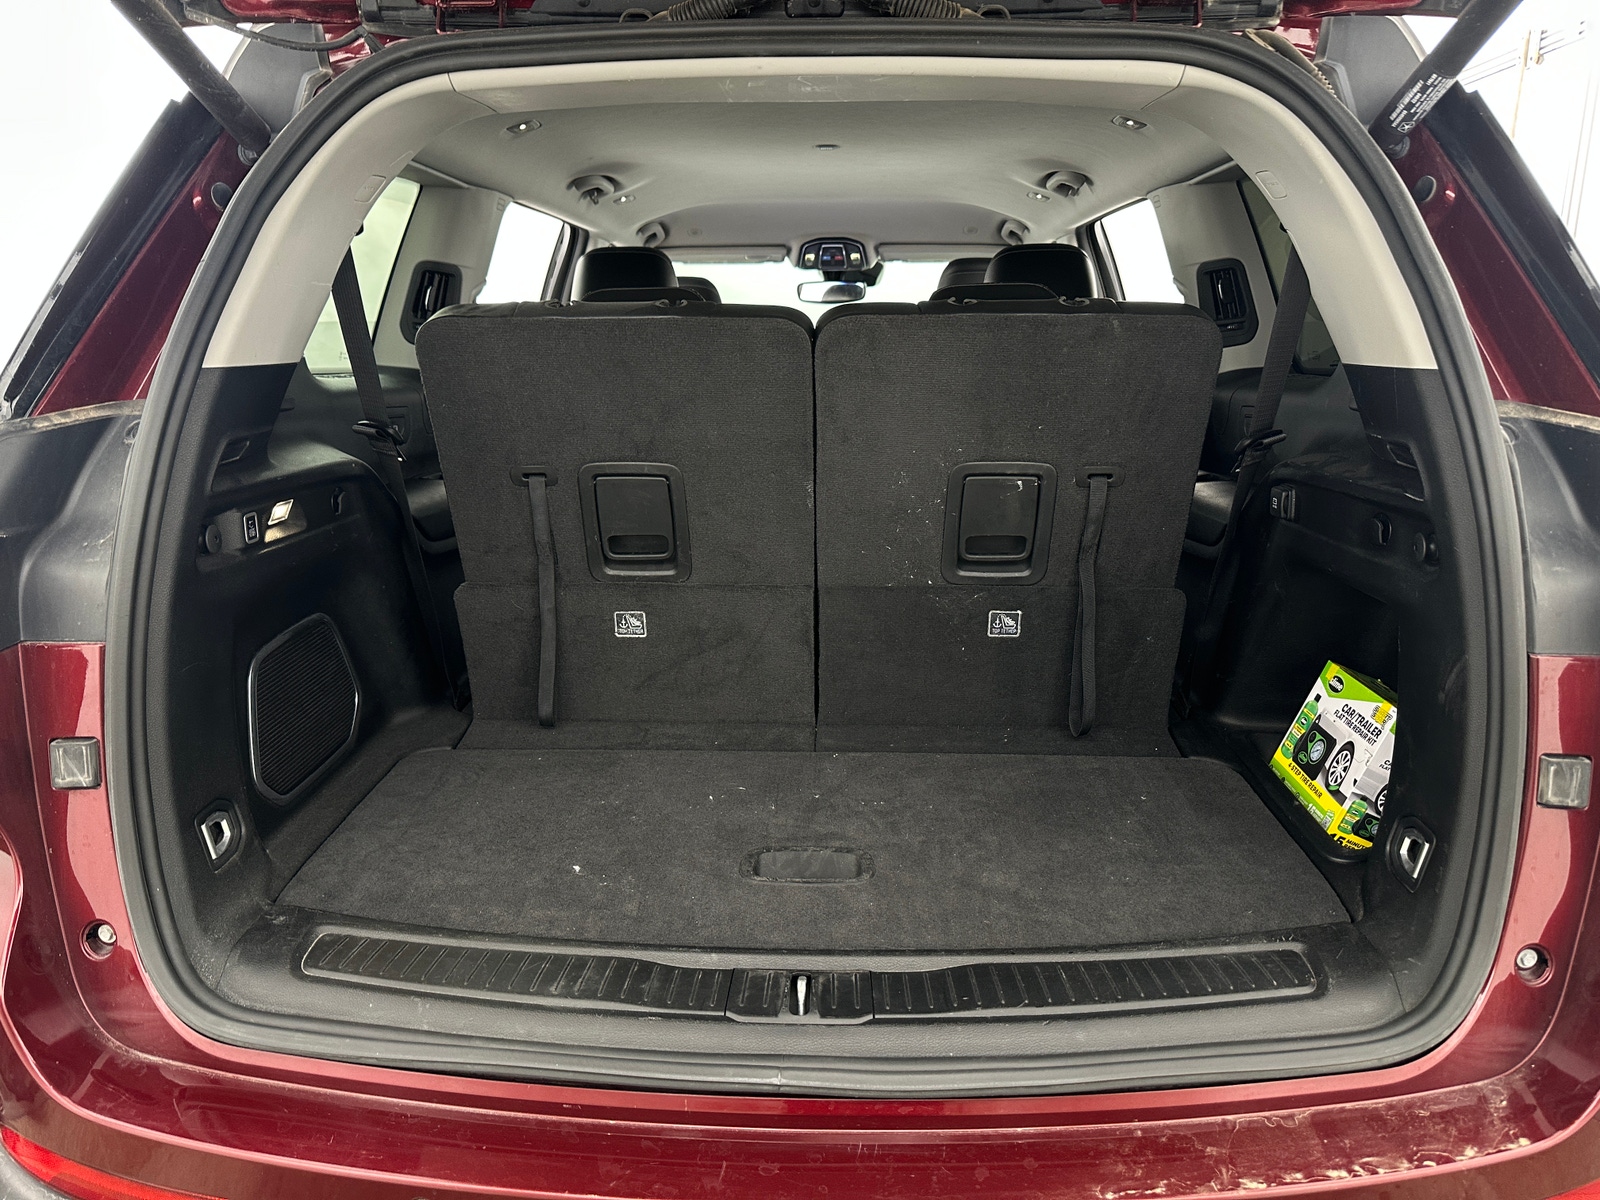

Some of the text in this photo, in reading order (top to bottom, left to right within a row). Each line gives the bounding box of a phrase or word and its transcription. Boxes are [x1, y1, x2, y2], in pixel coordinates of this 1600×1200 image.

[1333, 709, 1346, 722] FLAT
[1343, 716, 1355, 730] TIRE
[1351, 722, 1369, 741] REPAIR
[1366, 735, 1377, 747] KIT
[1341, 703, 1383, 740] CAR/TRAILER
[1288, 763, 1302, 777] 4-STEP
[1299, 773, 1310, 786] TIRE
[1307, 781, 1323, 799] REPAIR
